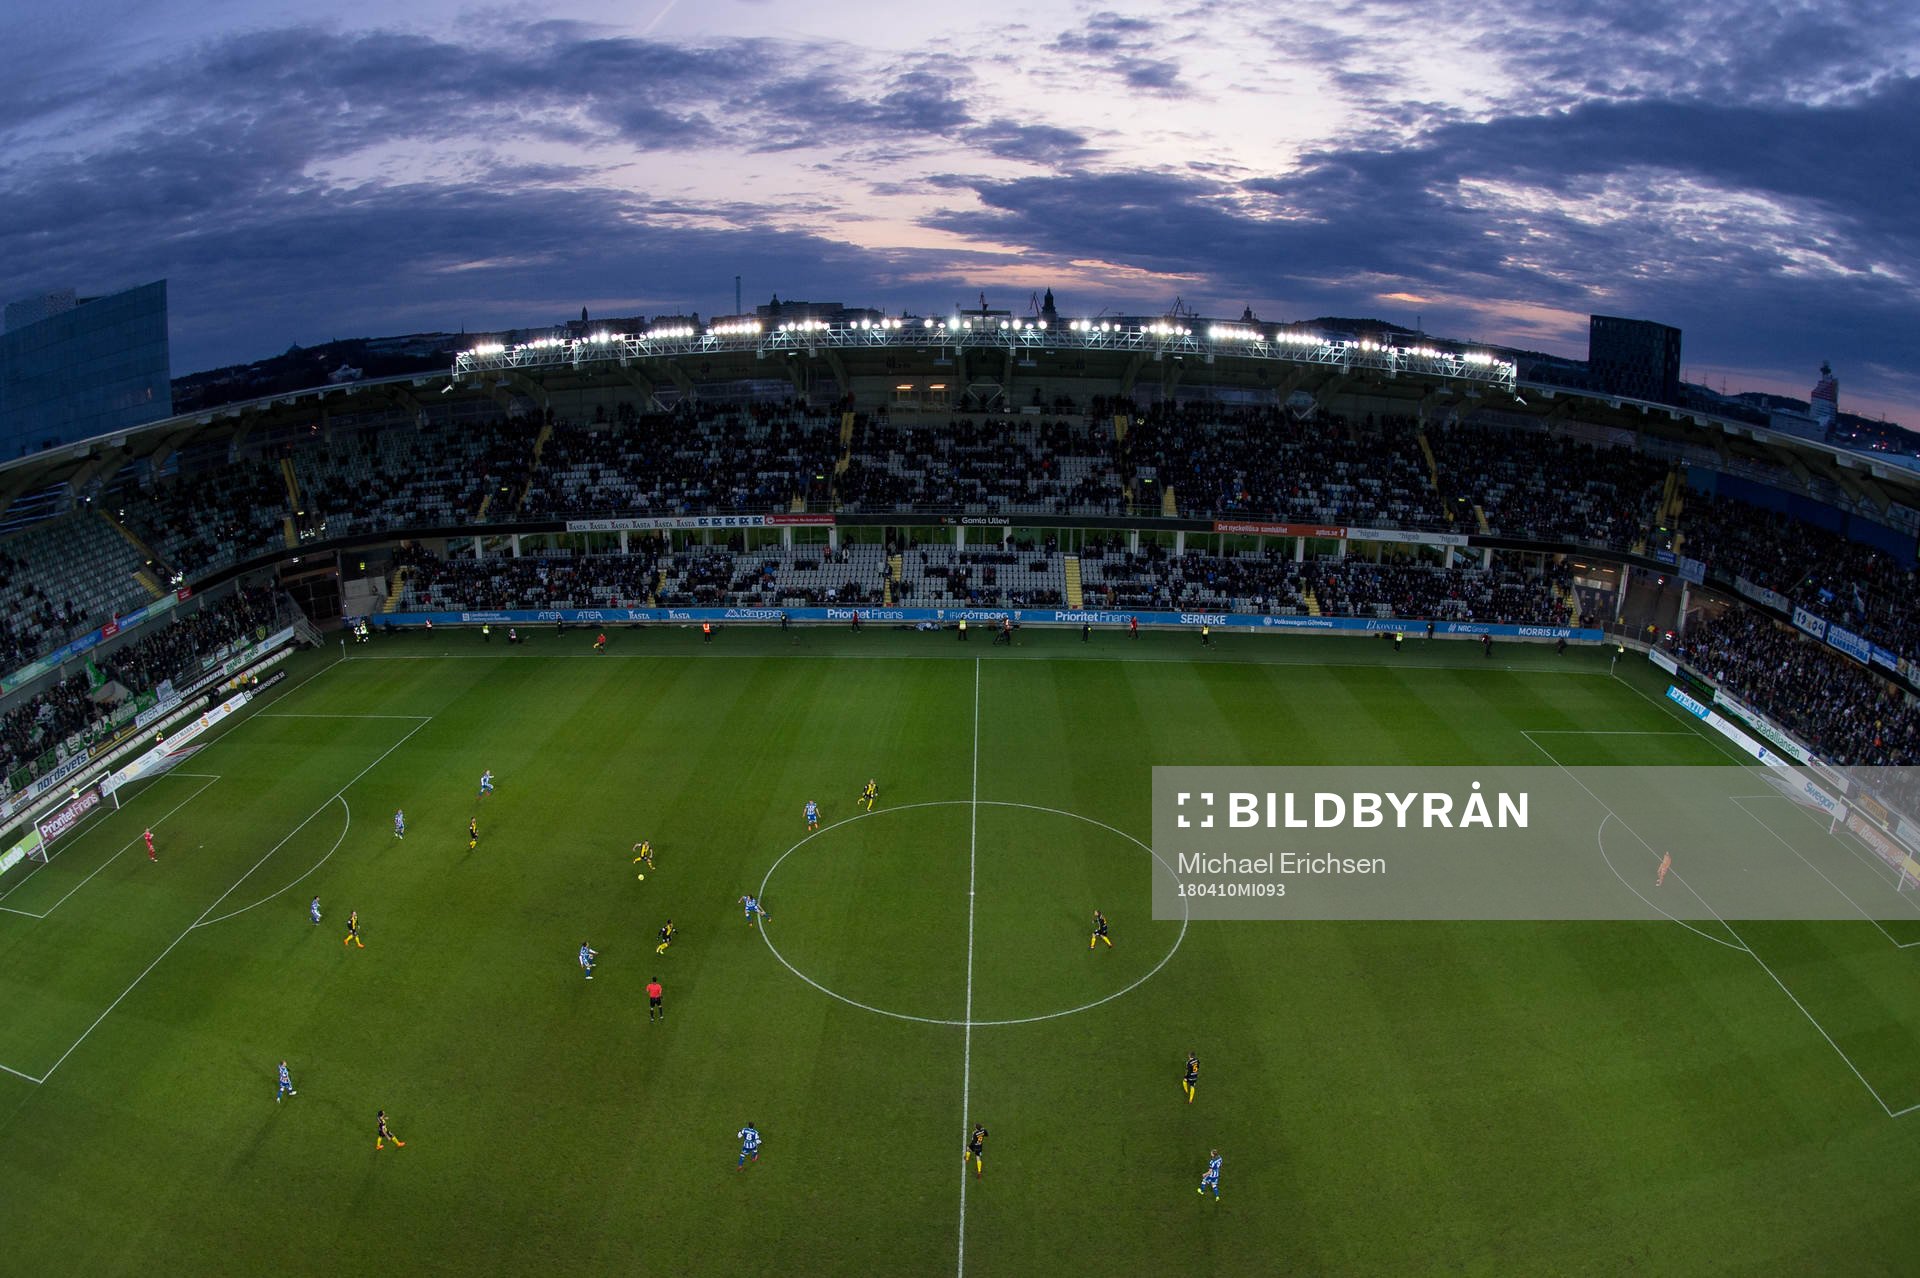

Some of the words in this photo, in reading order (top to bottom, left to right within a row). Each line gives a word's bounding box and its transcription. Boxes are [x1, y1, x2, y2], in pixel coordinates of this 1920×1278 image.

[961, 516, 986, 524] Gamla
[988, 516, 1010, 525] Ullevi
[1218, 523, 1228, 531] Det
[741, 609, 782, 619] Kappa
[872, 609, 904, 619] Finans
[960, 609, 1009, 620] GÖTEBORG
[1055, 611, 1099, 622] Prioritet
[1100, 612, 1132, 623] Finans
[1180, 613, 1226, 625] SERNEKE
[1273, 618, 1307, 627] Volkswagen
[1518, 627, 1550, 637] MORRIS
[1552, 629, 1571, 638] LAW
[1756, 719, 1800, 758] Stadalliansen
[37, 751, 87, 792] nordsvets
[1804, 782, 1835, 810] Swegon
[40, 812, 76, 838] Prioritet
[72, 793, 98, 815] Finans
